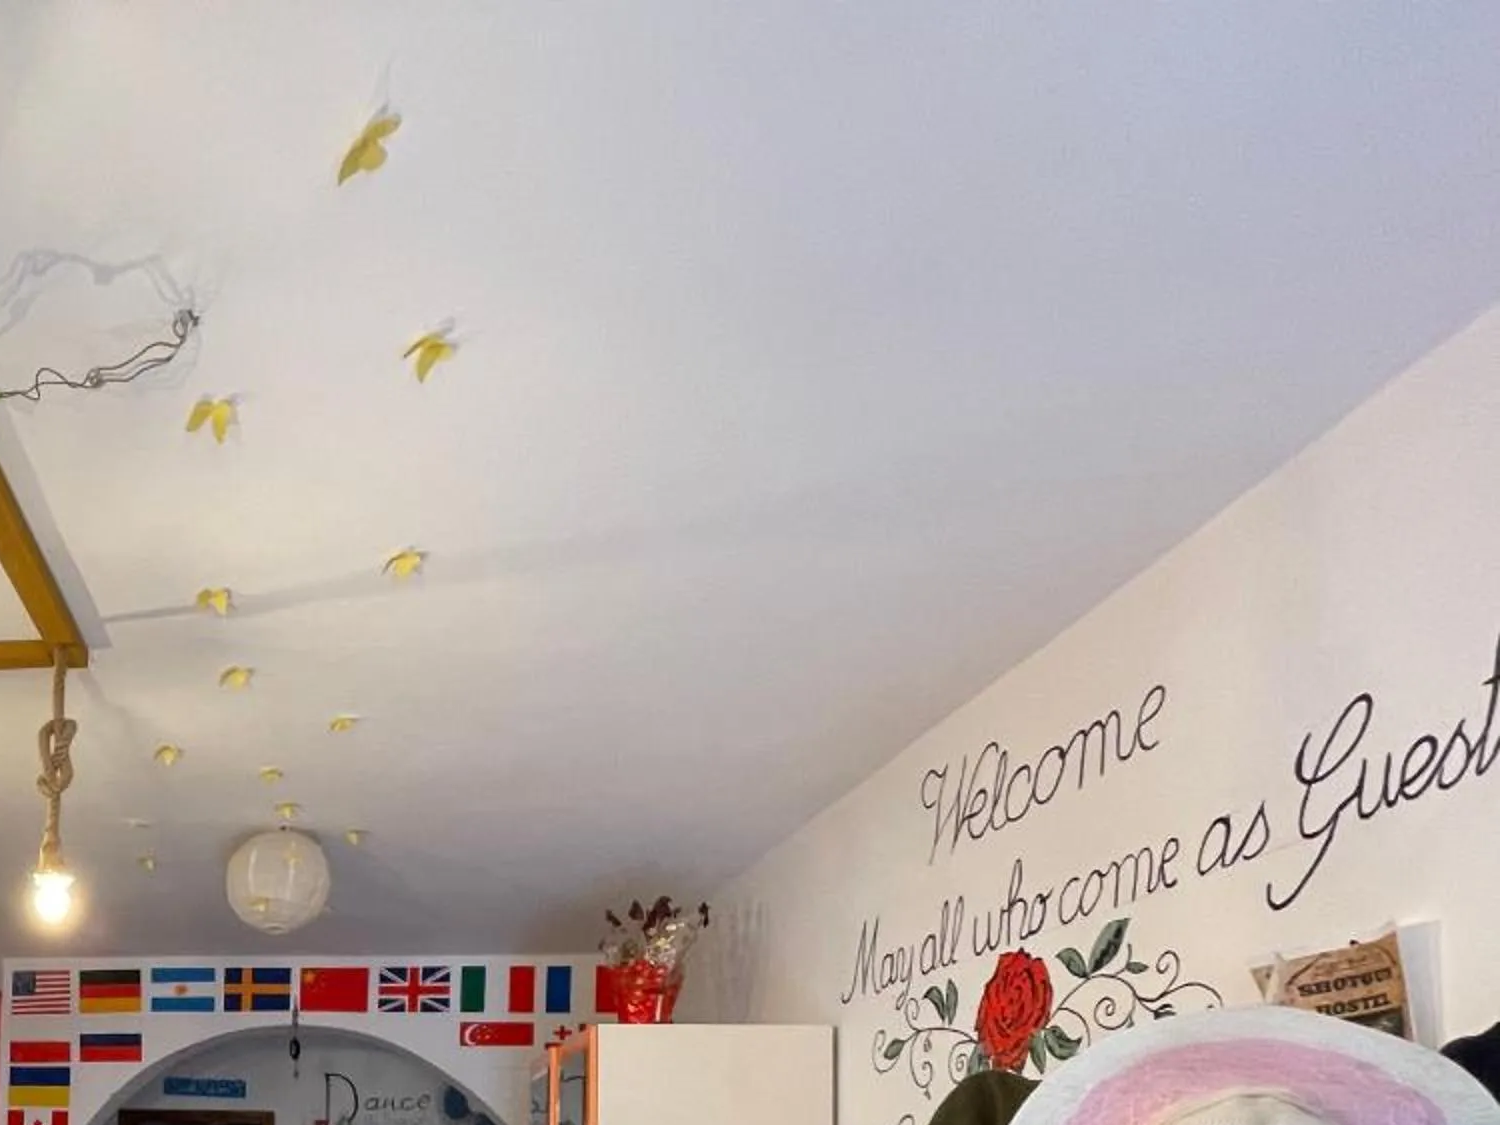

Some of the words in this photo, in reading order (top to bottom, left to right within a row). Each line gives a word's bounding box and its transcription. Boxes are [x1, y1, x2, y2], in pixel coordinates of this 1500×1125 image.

[920, 685, 1166, 866] Welcome
[918, 895, 965, 967] all
[972, 859, 1053, 954] who
[1057, 836, 1180, 925] come
[1196, 801, 1271, 876] as
